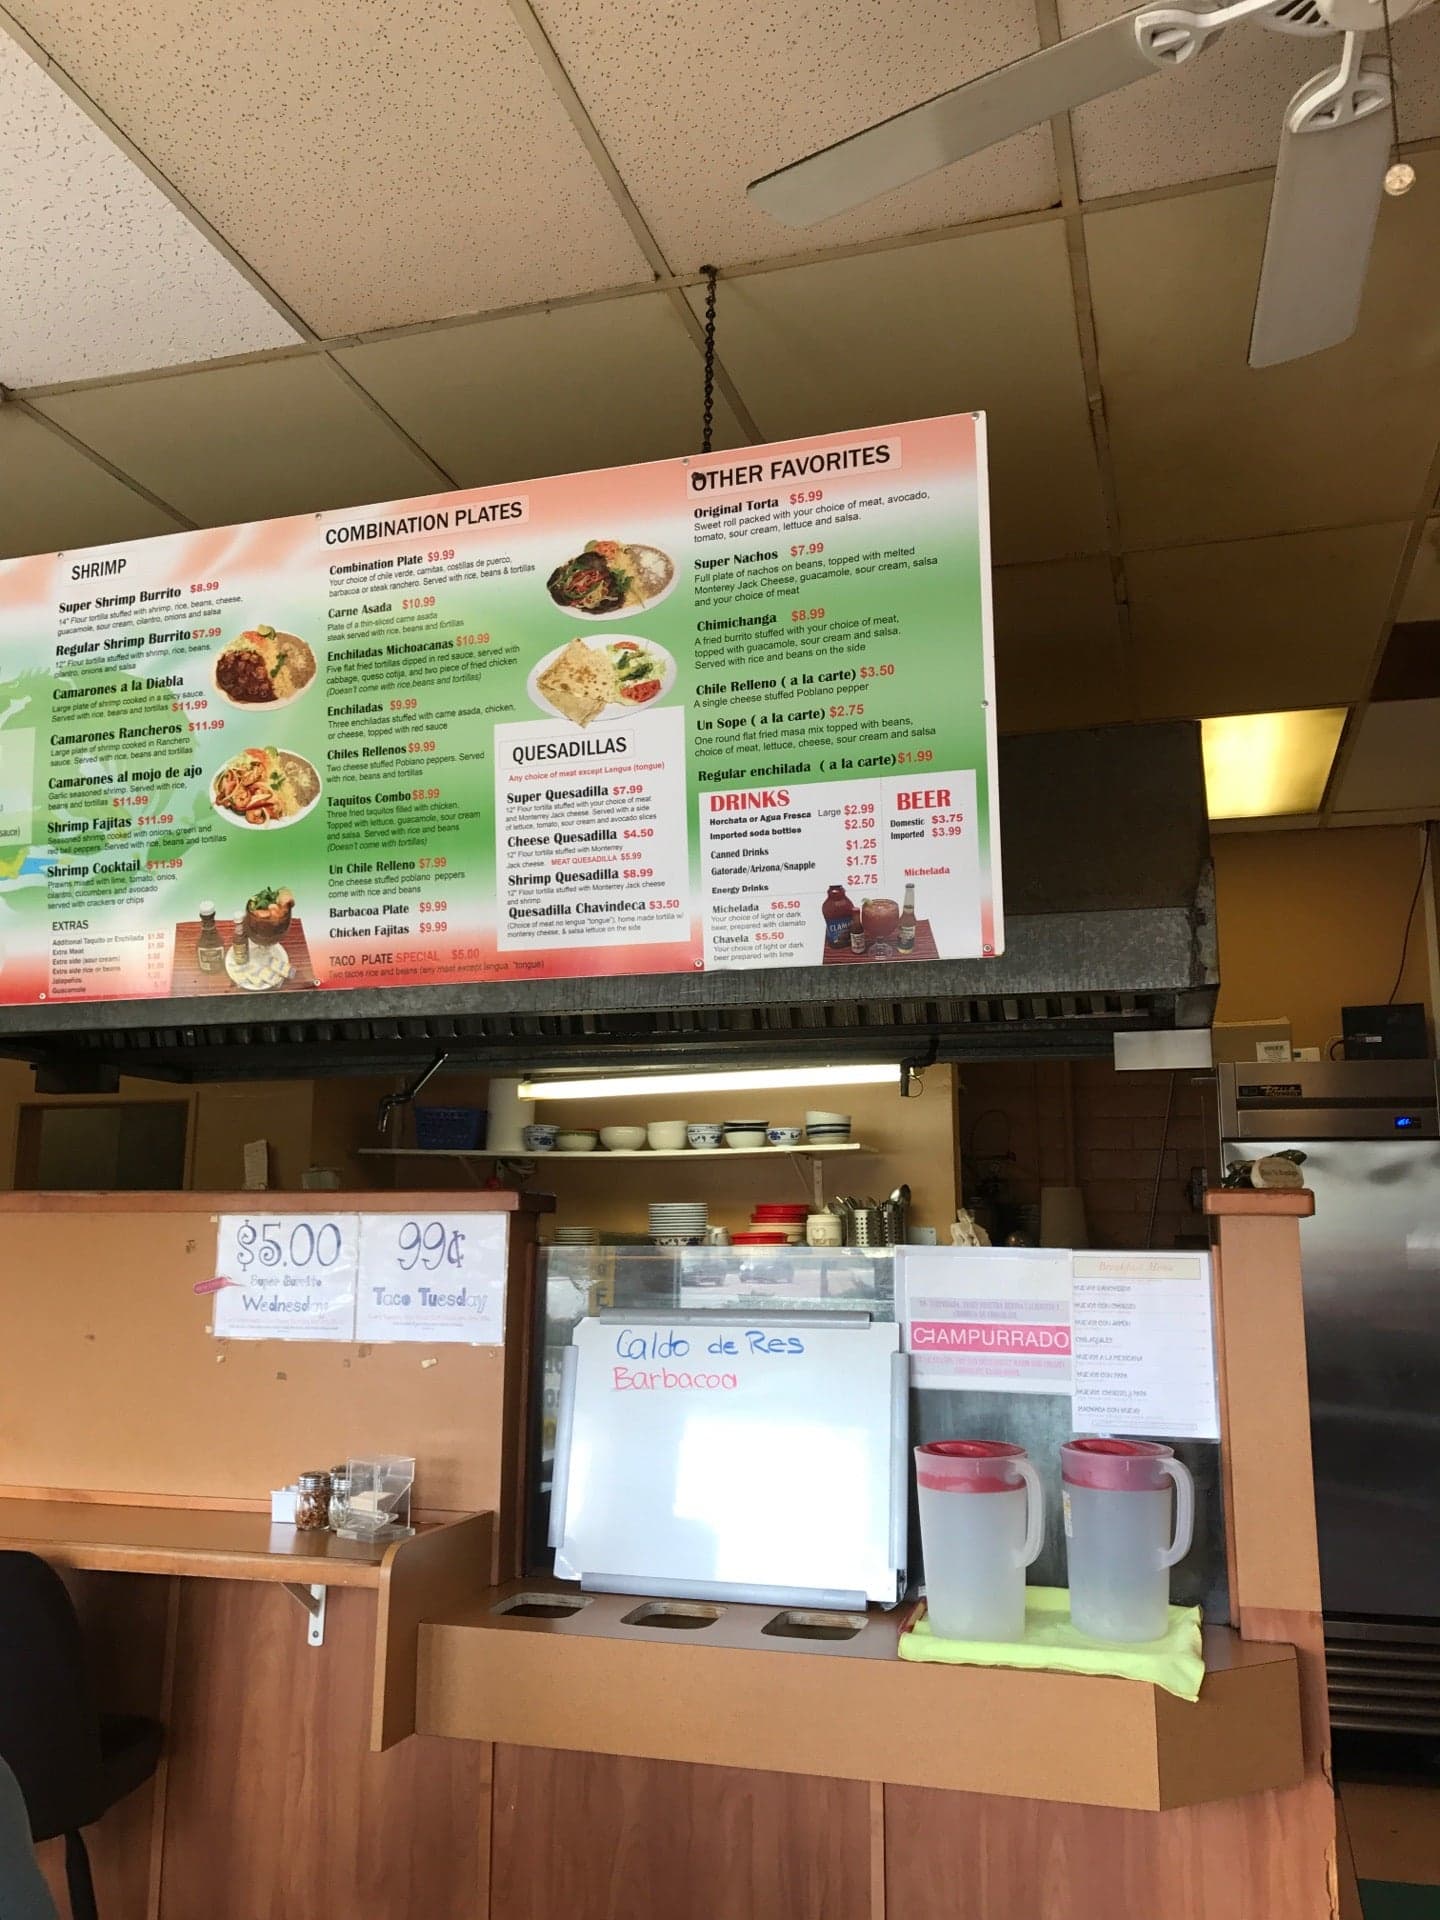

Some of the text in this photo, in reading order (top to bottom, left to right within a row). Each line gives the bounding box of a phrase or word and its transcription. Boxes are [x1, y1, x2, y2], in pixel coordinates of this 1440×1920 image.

[691, 446, 890, 491] OTHER FAVORITES
[694, 490, 823, 521] Original Torta $5.99
[694, 519, 721, 531] Sweet
[723, 517, 737, 527] roll
[739, 513, 771, 527] packed
[772, 510, 791, 520] with
[793, 509, 813, 519] your
[815, 503, 845, 515] choice
[847, 501, 857, 510] of
[325, 502, 522, 545] COMBINATION PLATES
[329, 549, 455, 575] Combination Plate $9.99
[694, 543, 824, 572] Super Nachos $7.99
[71, 558, 127, 580] SHRIMP
[59, 581, 219, 615] Super Shrimp Burrito $8.99
[328, 597, 436, 618] Carne Asada $10.99
[697, 608, 825, 634] Chimichanga $8.99
[56, 627, 222, 658] Regular Shrimp Burrito $7.99
[328, 634, 490, 661] Enchiladas Michoacanas $10.99
[694, 658, 726, 669] Served
[727, 656, 746, 666] with
[748, 655, 765, 663] rice
[766, 652, 784, 662] and
[785, 649, 813, 659] beans
[829, 645, 844, 655] the
[846, 643, 866, 653] side
[53, 675, 184, 700] Camarones a la Diabla
[696, 681, 727, 695] Chile
[731, 676, 777, 692] Relleno
[790, 677, 798, 686] a
[802, 673, 814, 685] la
[818, 669, 856, 686] carte)
[860, 666, 895, 678] $3.50
[171, 699, 208, 712] $11.99
[327, 699, 417, 716] Enchiladas $9.99
[693, 684, 869, 709] A single cheese stuffed Poblano pepper
[50, 719, 224, 745] Camarones Rancheros $11.99
[327, 741, 436, 760] Chiles Rellenos $9.99
[513, 737, 627, 764] QUESADILLAS
[48, 766, 202, 789] Camarones al mojo de ajo
[112, 795, 149, 807] $11.99
[327, 789, 440, 809] Taquitos Combo $8.99
[507, 784, 643, 805] Super Quesadilla $7.99
[711, 790, 790, 812] DRINKS
[897, 790, 951, 811] BEER
[48, 813, 174, 835] Shrimp Fajitas $11.99
[710, 815, 747, 826] Horchata
[760, 813, 781, 824] Agua
[783, 811, 811, 821] Fresca
[818, 808, 841, 819] Large
[844, 804, 874, 815] $2.99
[890, 813, 963, 827] Domestic $3.75
[508, 828, 654, 847] Cheese Quesadilla $4.50
[710, 818, 875, 841] Imported soda bottles $2.50
[890, 826, 961, 842] Imported $3.99
[711, 838, 877, 859] Canned Drinks $1.25
[47, 857, 183, 880] Shrimp Cocktail $11.99
[329, 858, 447, 874] Un Chile Relleno $7.99
[711, 855, 877, 877] Gatorade/Arizona/Snapple $1.75
[904, 866, 950, 876] Michelada
[508, 868, 653, 888] Shrimp Quesadilla $8.99
[329, 902, 447, 918] Barbacoa Plate $9.99
[509, 899, 680, 917] Quesadilla Chavindeca $3.50
[712, 900, 800, 912] Michelada $6.50
[52, 920, 89, 930] EXTRAS
[329, 922, 447, 938] Chicken Fajitas $9.99
[713, 931, 784, 943] Chavela $5.50
[237, 1219, 342, 1271] $5.00
[397, 1221, 466, 1271] 99¢
[372, 1287, 489, 1314] Taco Tuesday
[616, 1329, 805, 1361] Caldo de Res
[613, 1366, 738, 1391] Barbacoa
